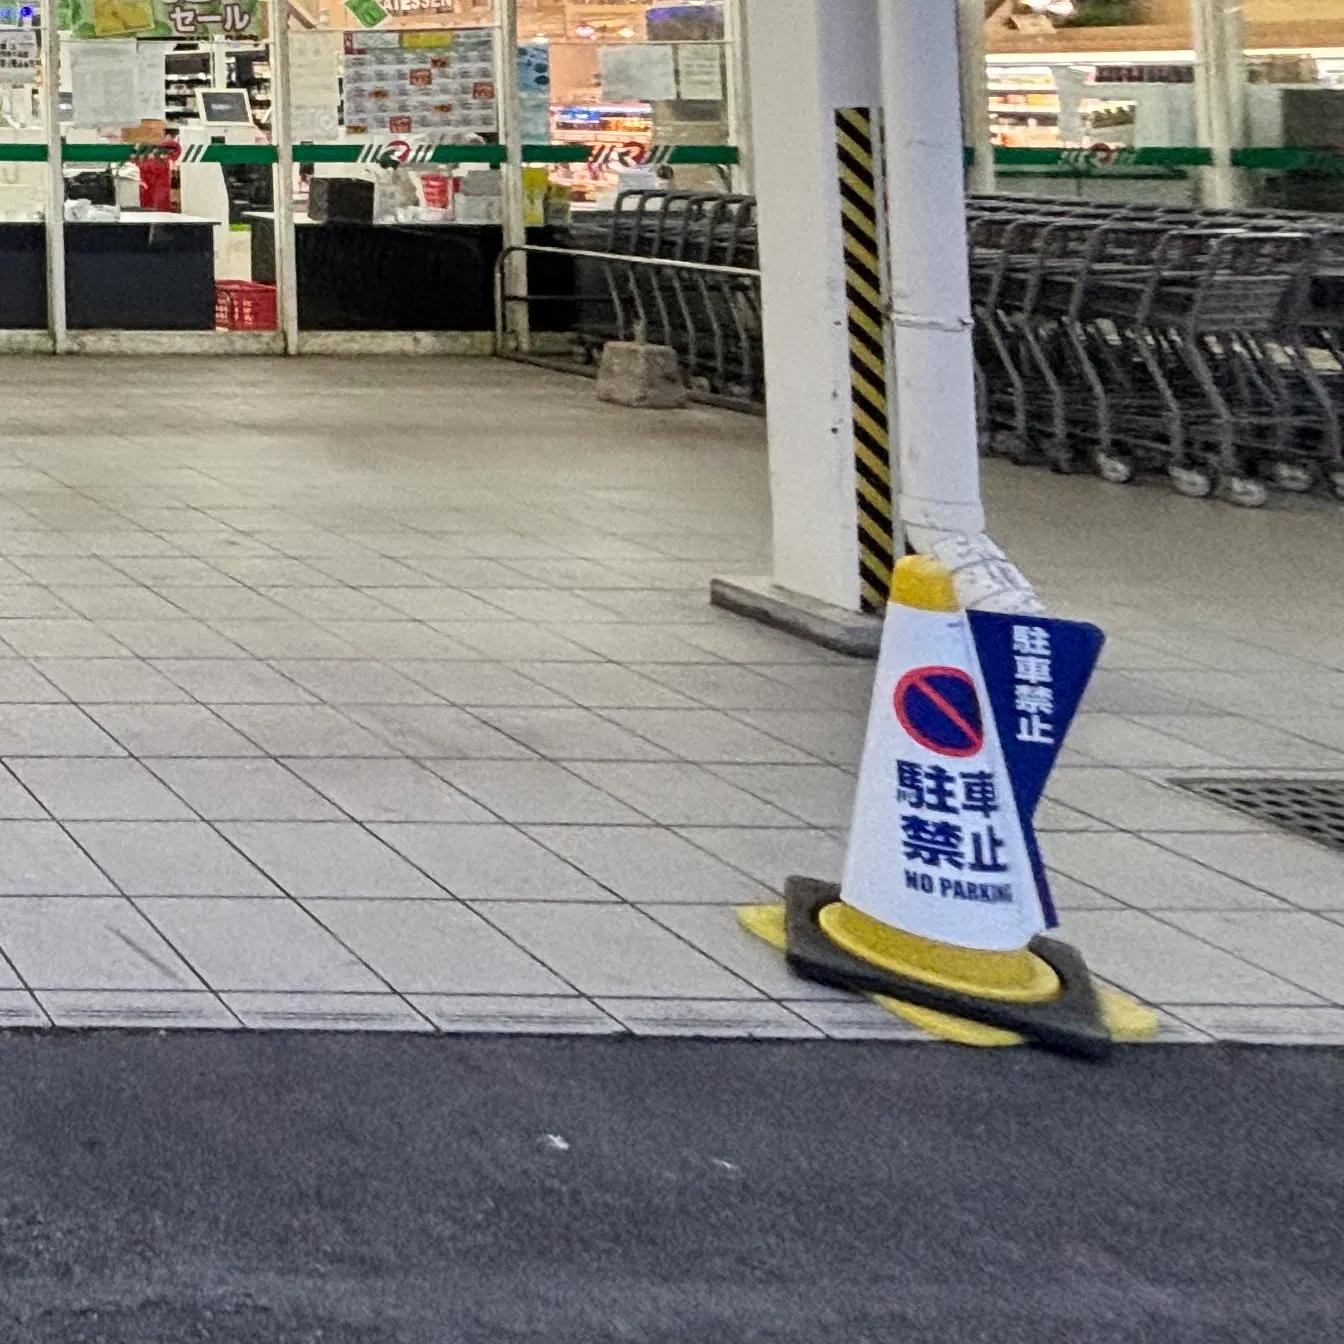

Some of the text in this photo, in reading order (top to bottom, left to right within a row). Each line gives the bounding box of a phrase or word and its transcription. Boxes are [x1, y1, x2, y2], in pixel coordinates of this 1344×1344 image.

[170, 3, 250, 34] セール
[1012, 624, 1055, 744] 駐車禁止
[896, 759, 999, 818] 駐車
[900, 814, 1009, 873] 禁止
[905, 868, 934, 893] NO
